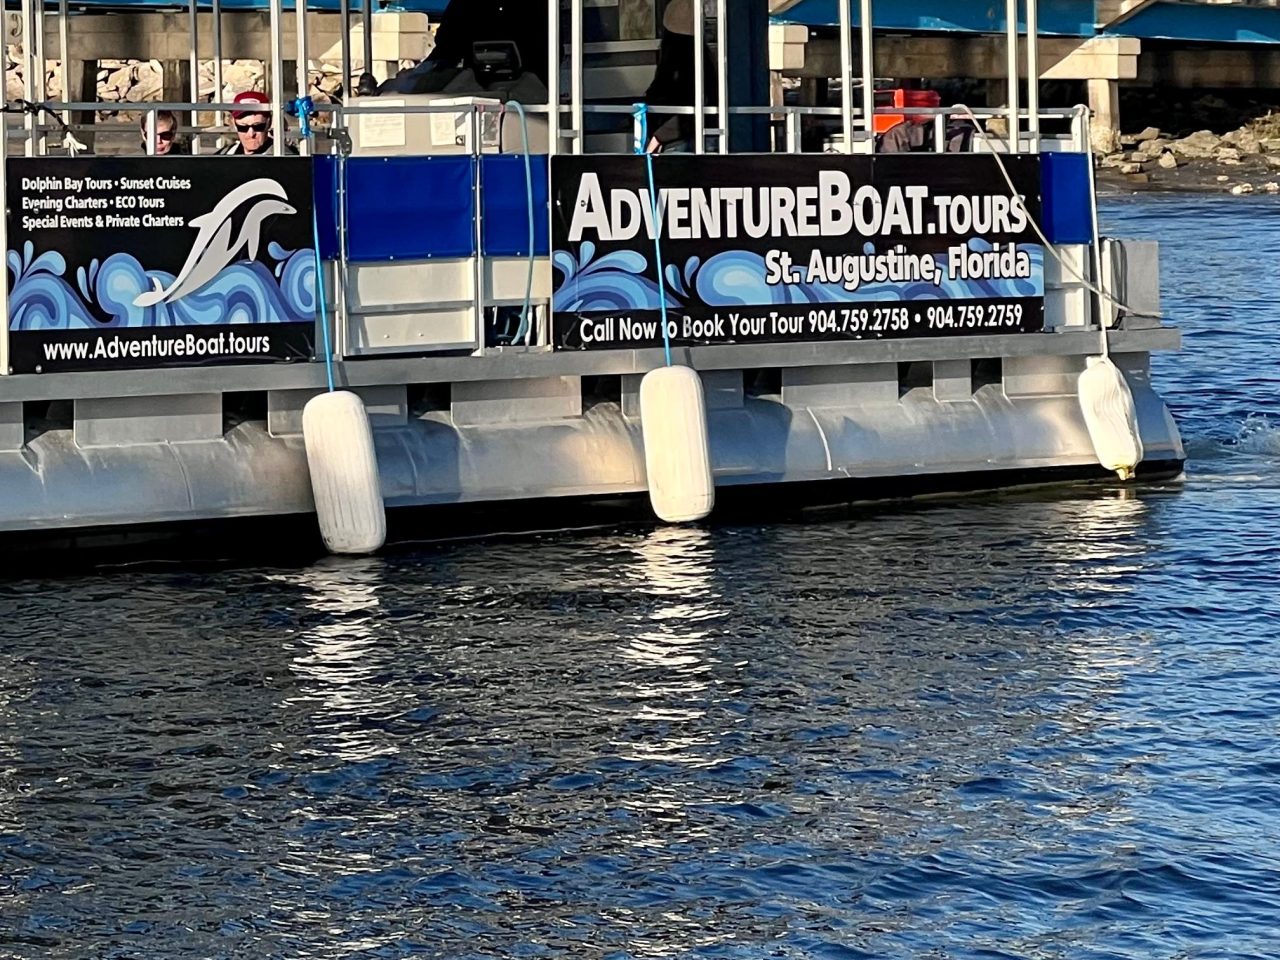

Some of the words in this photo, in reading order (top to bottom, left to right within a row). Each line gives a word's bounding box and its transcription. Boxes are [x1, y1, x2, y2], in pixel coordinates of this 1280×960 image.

[22, 176, 62, 193] Dolphin
[64, 177, 83, 193] Bay
[85, 177, 112, 190] Tours
[121, 177, 154, 190] Sunset
[155, 176, 191, 189] Cruises
[22, 196, 63, 212] Evening
[65, 196, 108, 209] Charters
[115, 196, 136, 208] ECO
[137, 196, 165, 208] Tours
[22, 215, 58, 231] Special
[60, 215, 93, 228] Events
[95, 215, 104, 227] &
[106, 214, 140, 227] Private
[142, 213, 184, 227] Charters
[765, 249, 800, 284] St.
[806, 244, 942, 290] Augustine,
[948, 242, 1030, 280] Florida
[579, 318, 614, 342] Call
[620, 317, 657, 340] Now
[683, 314, 725, 338] Book
[729, 313, 766, 336] Your
[770, 311, 804, 334] Tour
[809, 308, 909, 333] 904.759.2758
[927, 304, 1023, 328] 904.759.2759
[43, 331, 270, 360] www.AdventureBoat.tours
